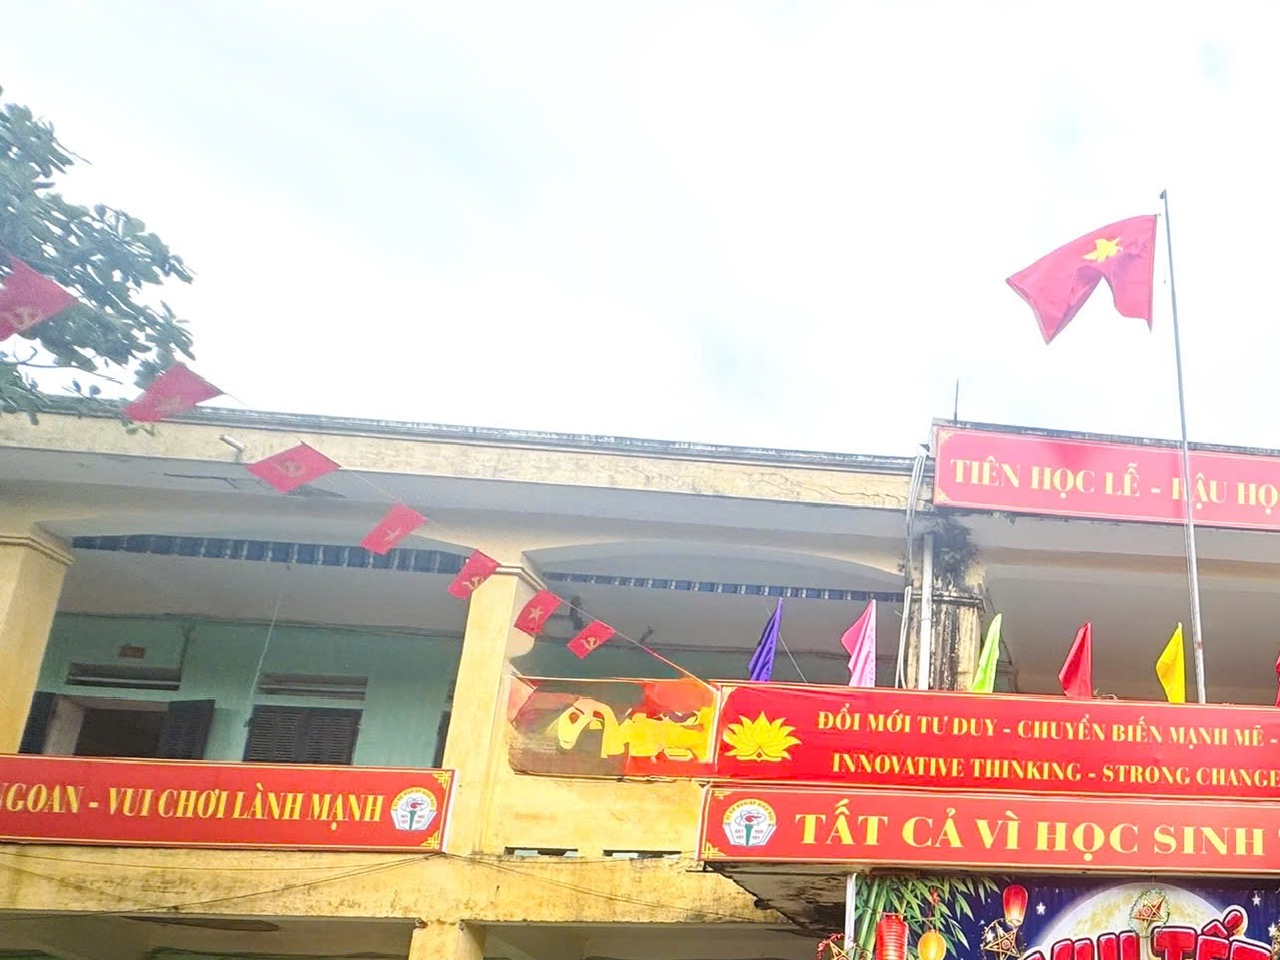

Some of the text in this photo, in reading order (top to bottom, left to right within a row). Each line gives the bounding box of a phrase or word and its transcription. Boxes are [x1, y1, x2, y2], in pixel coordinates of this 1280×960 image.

[949, 455, 1021, 489] TIÊN
[1030, 466, 1095, 499] HỌC
[1104, 462, 1141, 498] LỄ
[817, 703, 861, 731] ĐỔI
[866, 709, 912, 733] MỚI
[917, 715, 948, 735] TƯ
[952, 717, 997, 736] DUY
[1017, 713, 1106, 741] CHUYỂN
[1112, 716, 1162, 743] BIẾN
[1168, 726, 1229, 749] MẠNH
[1234, 725, 1265, 747] MẼ
[832, 752, 965, 777] INNOVATIVE
[970, 758, 1082, 781] THINKING
[1102, 763, 1191, 785] STRONG
[109, 787, 155, 816] VUI
[157, 787, 229, 819] CHƠI
[232, 782, 304, 820] LÀNH
[307, 793, 385, 831] MẠNH
[795, 798, 888, 845] TẤT
[902, 807, 964, 848] CẢ
[975, 809, 1021, 850] VÌ
[1035, 820, 1139, 862] HỌC
[1153, 824, 1266, 856] SINH
